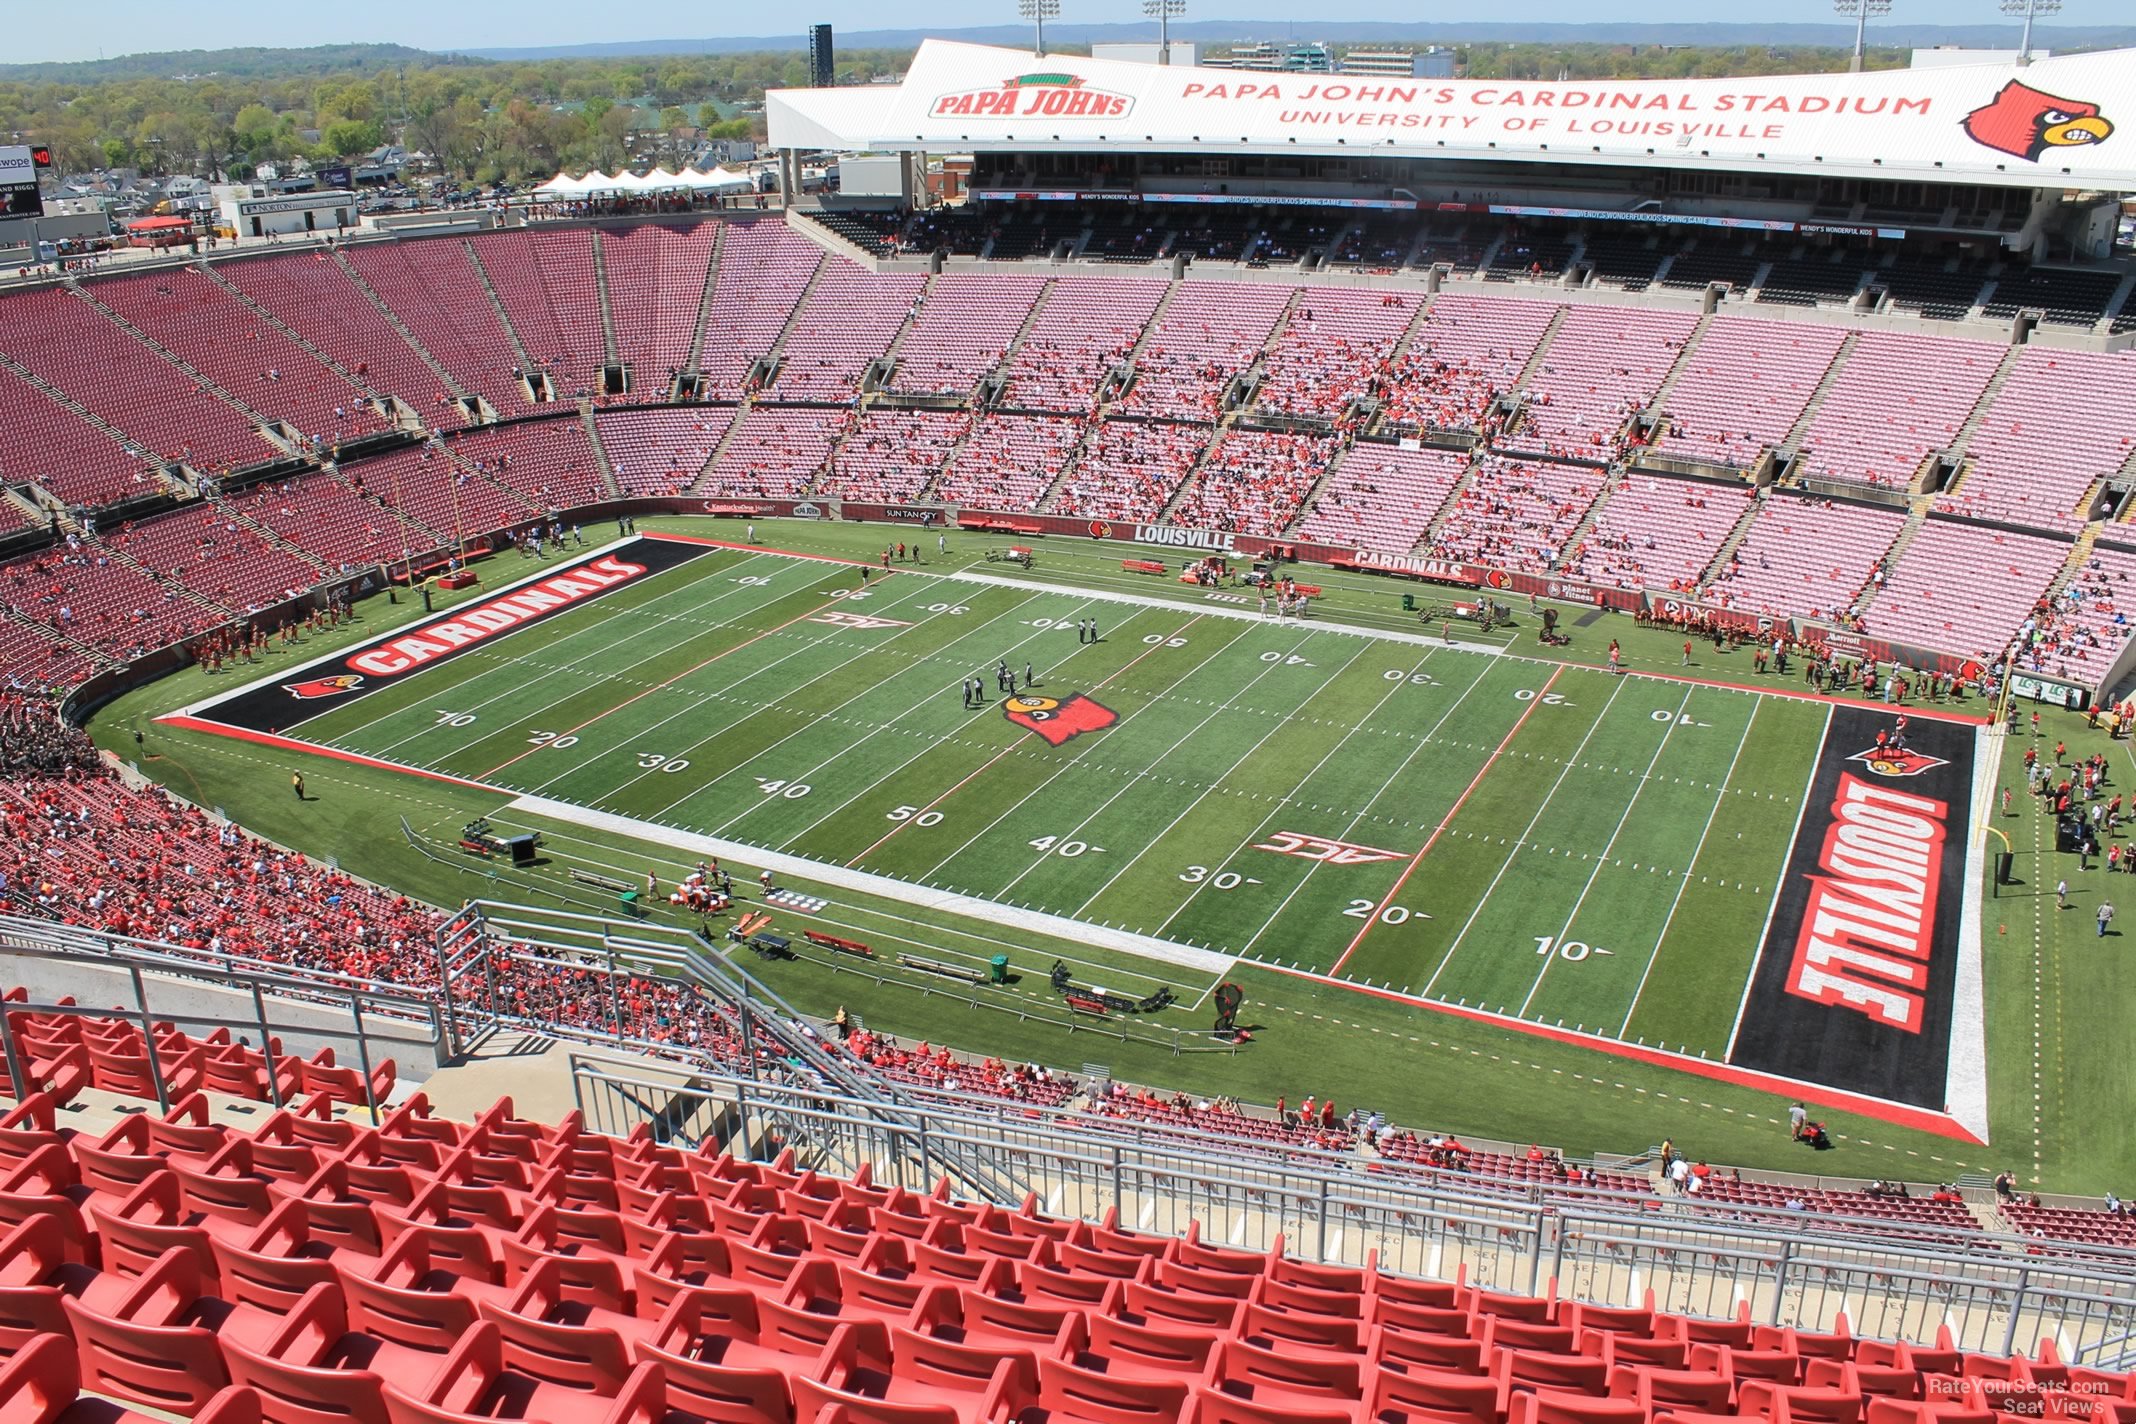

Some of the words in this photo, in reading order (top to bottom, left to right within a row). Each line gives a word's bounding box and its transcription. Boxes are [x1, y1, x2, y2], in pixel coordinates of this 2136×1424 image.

[935, 90, 1019, 114] PAPA
[1182, 84, 1280, 98] PAPA
[1297, 85, 1455, 104] JOHN'S
[1470, 88, 1698, 110] CARDINAL
[1712, 94, 1932, 115] STADIUM
[1279, 110, 1479, 129] UNIVERSITY
[1503, 117, 1549, 131] OF
[1567, 118, 1785, 138] LOUISVILLE
[34, 151, 48, 164] 40
[260, 203, 292, 212] NORTON
[886, 509, 900, 517] SUN
[1134, 526, 1235, 550] LOUISVILLE
[1354, 552, 1462, 577] CARDINALS
[355, 560, 640, 673] CARDINALS
[806, 611, 915, 628] ACC
[1142, 634, 1188, 647] 50
[1826, 632, 1860, 645] Marriott
[886, 805, 944, 827] 50
[1028, 836, 1088, 857] 40
[1249, 830, 1412, 864] ACC
[1178, 866, 1242, 889] 30
[1798, 780, 1936, 1024] LOUISVILLE
[1342, 899, 1409, 925] 20
[1533, 936, 1590, 962] 10
[1091, 1189, 1114, 1197] SEC
[1185, 1204, 1209, 1213] SEC
[1376, 1235, 1400, 1244] SEC
[1473, 1250, 1497, 1259] SEC
[1573, 1264, 1599, 1273] SEC
[1672, 1276, 1697, 1284] SEC
[1679, 1304, 1697, 1314] WA
[1880, 1301, 1907, 1311] SEC
